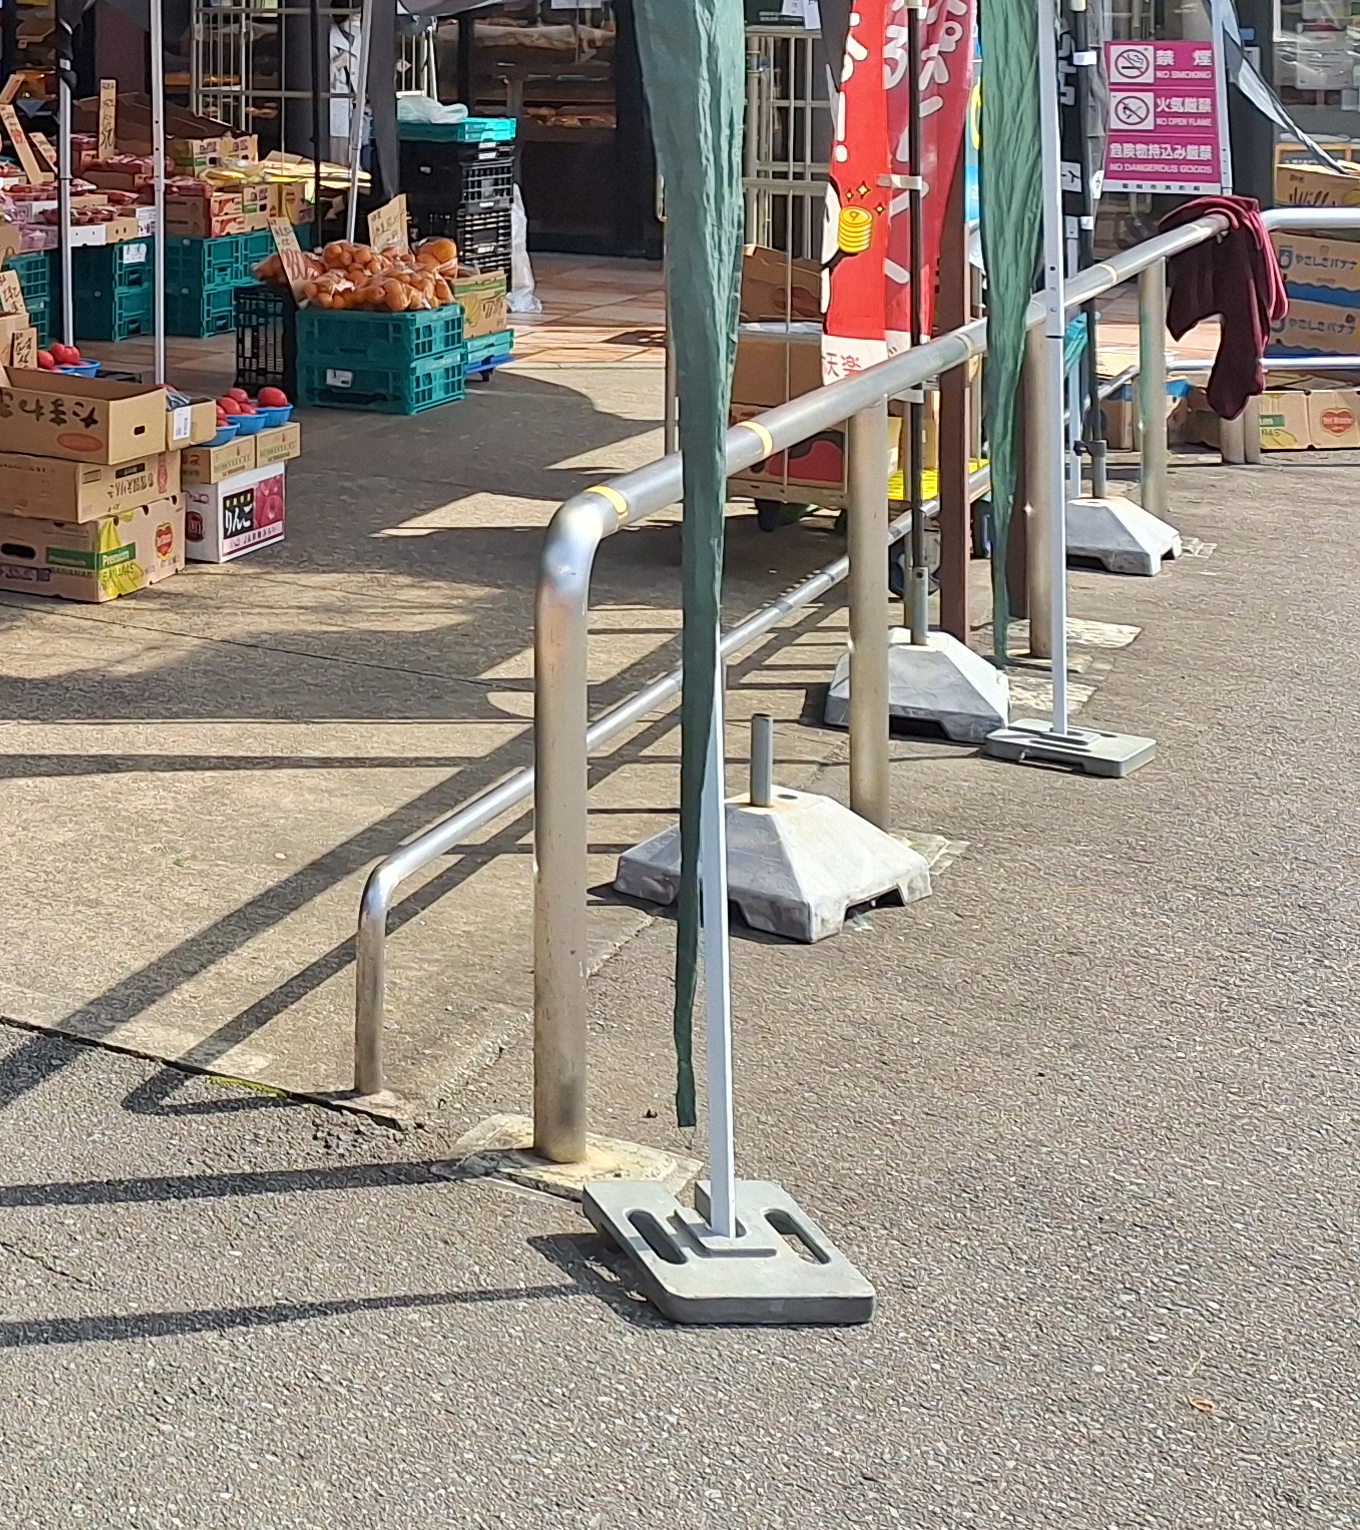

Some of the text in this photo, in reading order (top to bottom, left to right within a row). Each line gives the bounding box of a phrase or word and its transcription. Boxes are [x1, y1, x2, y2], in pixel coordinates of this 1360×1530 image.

[1171, 71, 1213, 79] SMOKING
[1168, 118, 1188, 126] OPEN
[1110, 163, 1213, 174] NO DANGEROUS GOODS
